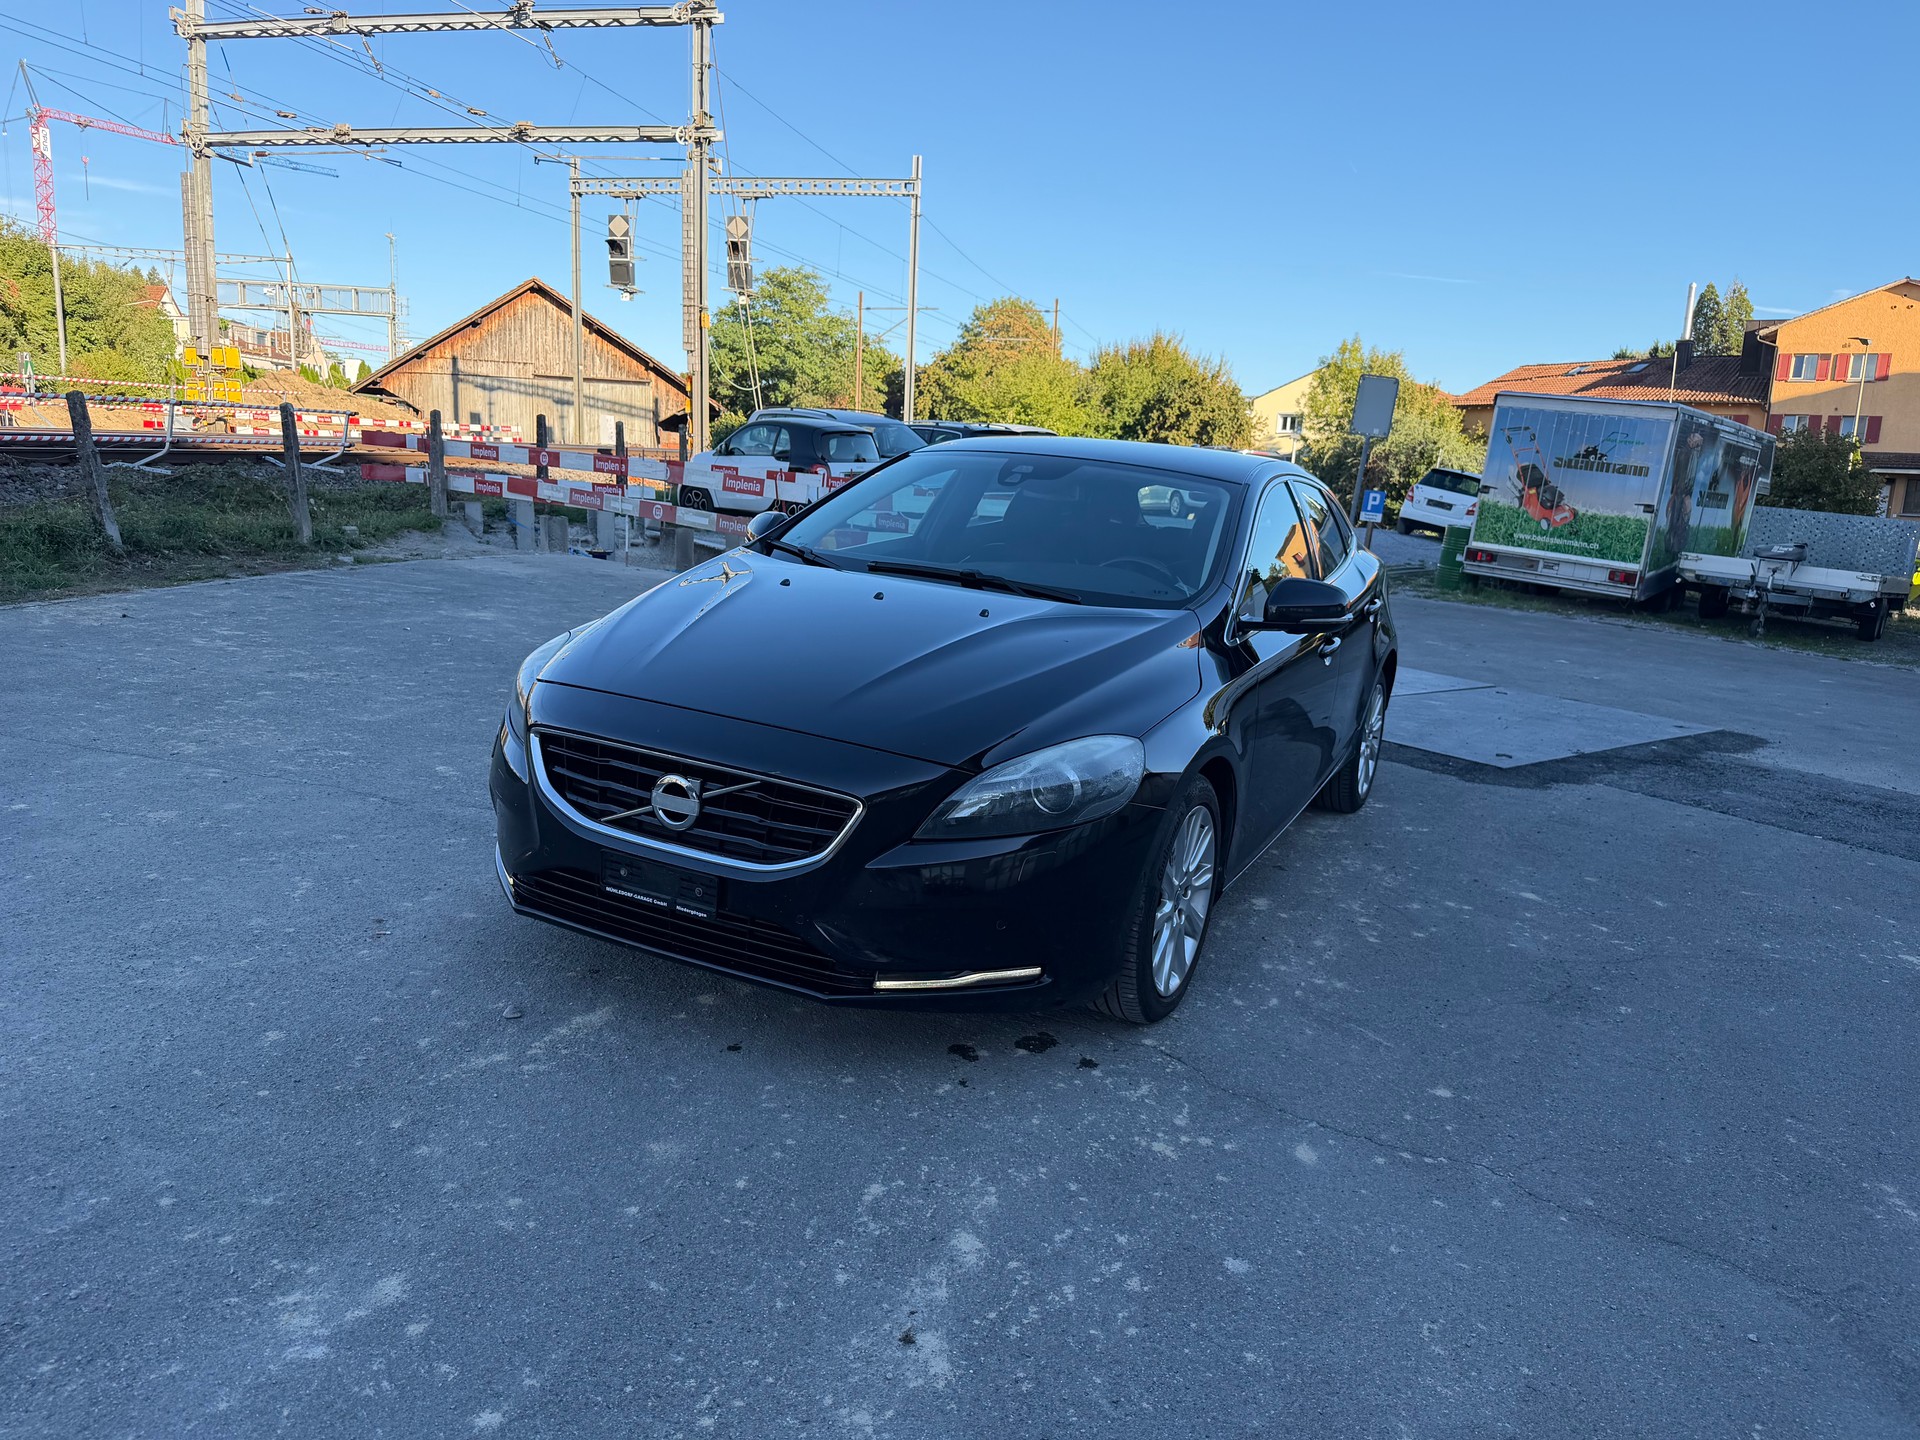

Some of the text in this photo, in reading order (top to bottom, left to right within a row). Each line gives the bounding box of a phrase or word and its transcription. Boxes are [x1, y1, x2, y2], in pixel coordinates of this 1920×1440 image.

[472, 445, 497, 458] Implenia
[595, 458, 626, 472] Implena
[475, 481, 501, 494] Implenia
[594, 483, 624, 495] Implenia
[725, 476, 761, 493] Implenia
[572, 491, 601, 506] Implenia
[1367, 493, 1380, 510] P
[719, 518, 748, 533] Implen
[878, 518, 906, 530] Implenia
[653, 898, 668, 907] GmbH
